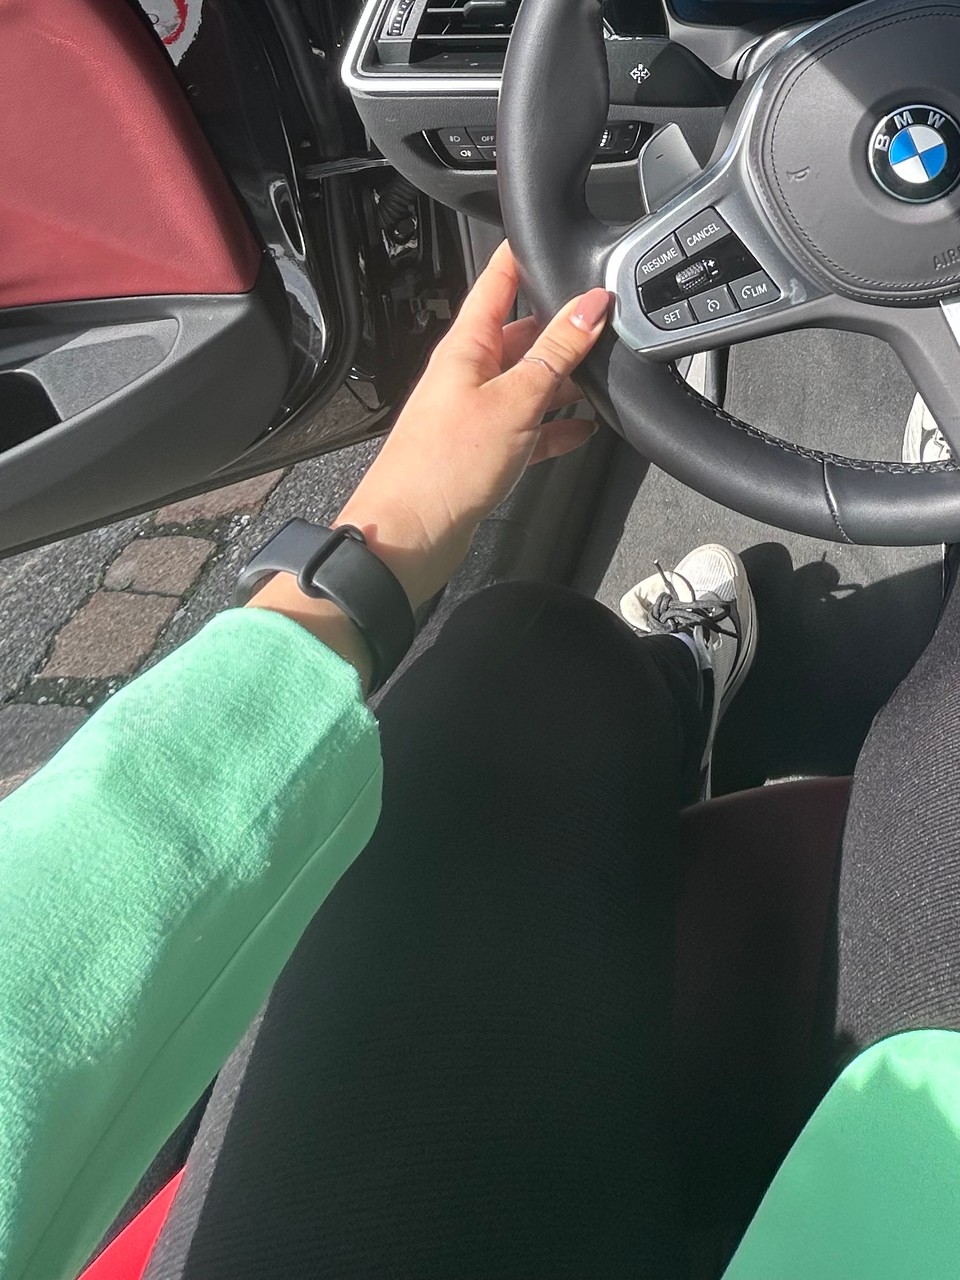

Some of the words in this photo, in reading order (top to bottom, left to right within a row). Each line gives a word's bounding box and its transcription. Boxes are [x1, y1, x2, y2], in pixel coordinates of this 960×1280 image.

[874, 110, 946, 152] BMW
[686, 221, 721, 247] CANCEL
[641, 247, 679, 275] RESUME
[751, 283, 768, 298] LIM
[663, 309, 682, 324] SET
